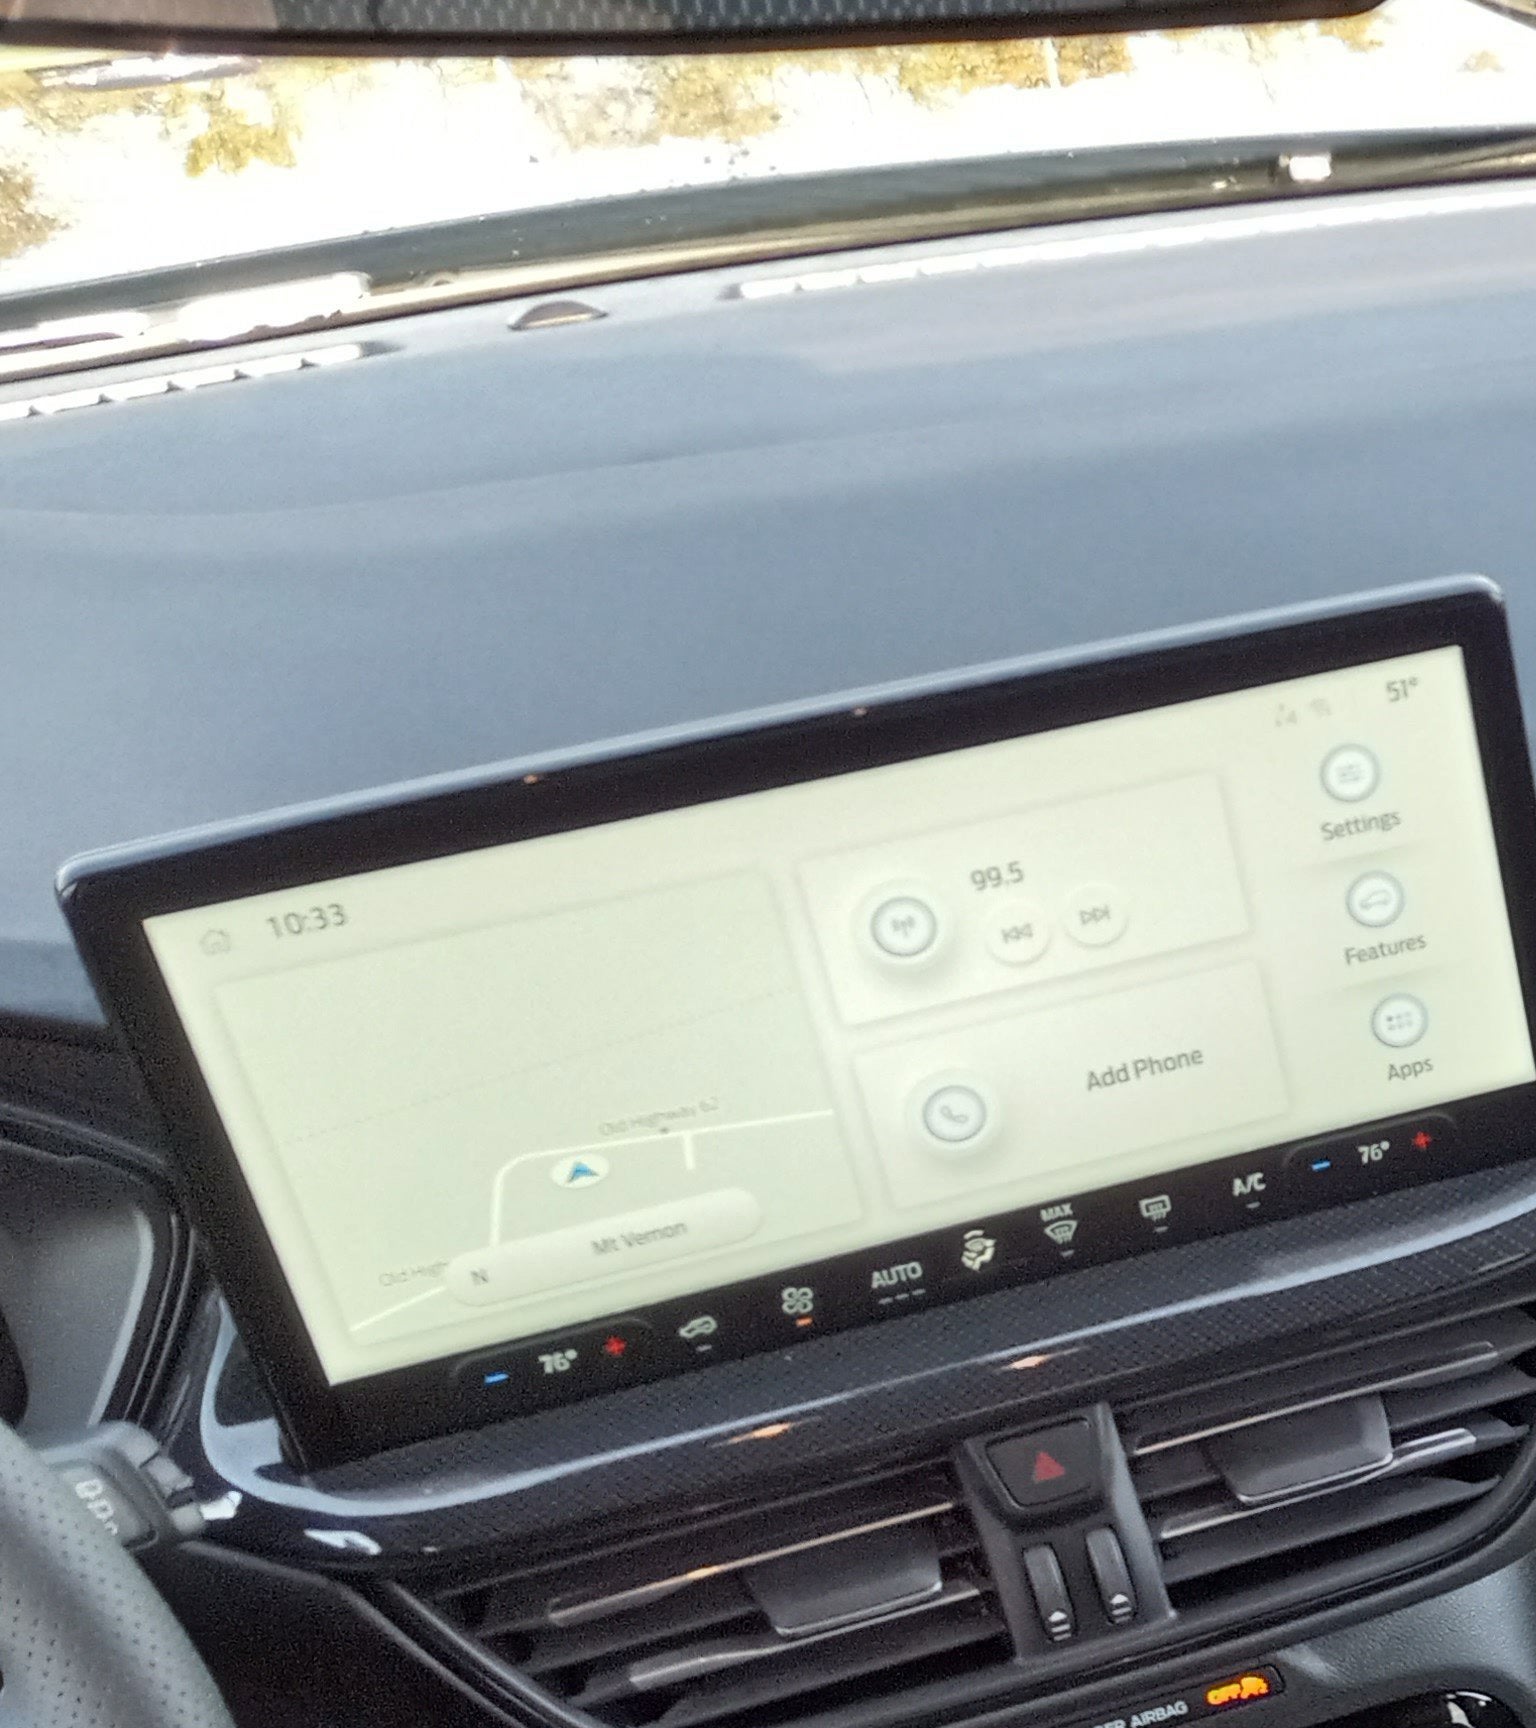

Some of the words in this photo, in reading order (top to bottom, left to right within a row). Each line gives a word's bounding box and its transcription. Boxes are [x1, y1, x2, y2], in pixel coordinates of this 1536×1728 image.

[1319, 811, 1402, 842] Settings
[970, 860, 1025, 891] 99.5
[266, 903, 347, 938] 10:33
[1344, 934, 1428, 966] Features
[1086, 1062, 1131, 1092] Add
[1132, 1048, 1205, 1080] Phone
[1387, 1057, 1435, 1082] Apps
[1232, 1171, 1267, 1198] A/C
[1039, 1202, 1073, 1224] MAX
[591, 1233, 620, 1257] Mt
[620, 1219, 688, 1250] Vernon
[870, 1261, 924, 1290] AUTO
